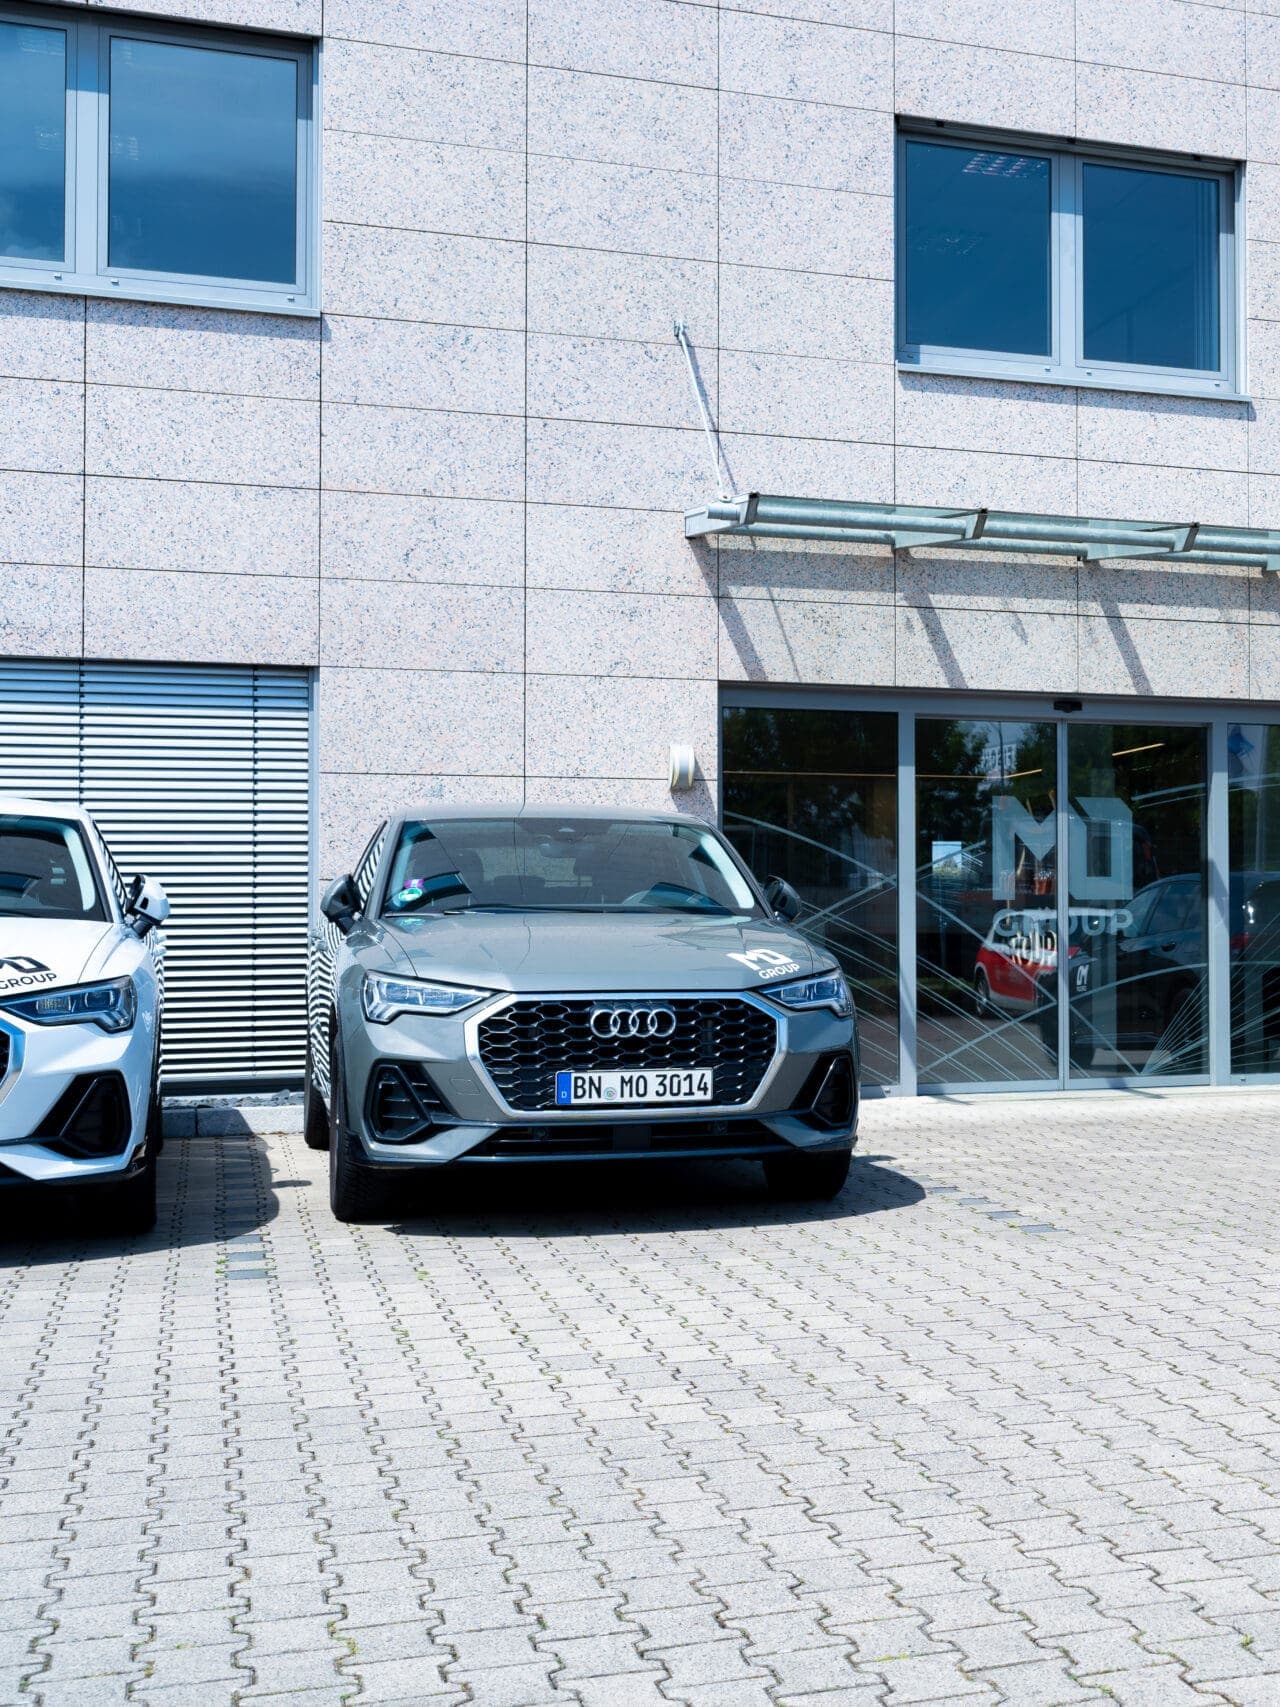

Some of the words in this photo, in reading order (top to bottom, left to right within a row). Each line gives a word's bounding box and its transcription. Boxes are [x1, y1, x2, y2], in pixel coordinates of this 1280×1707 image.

[994, 909, 1133, 936] GROUP
[759, 963, 800, 979] GROUP
[573, 1076, 602, 1099] BN
[620, 1075, 648, 1097] MO
[655, 1073, 709, 1096] 3014
